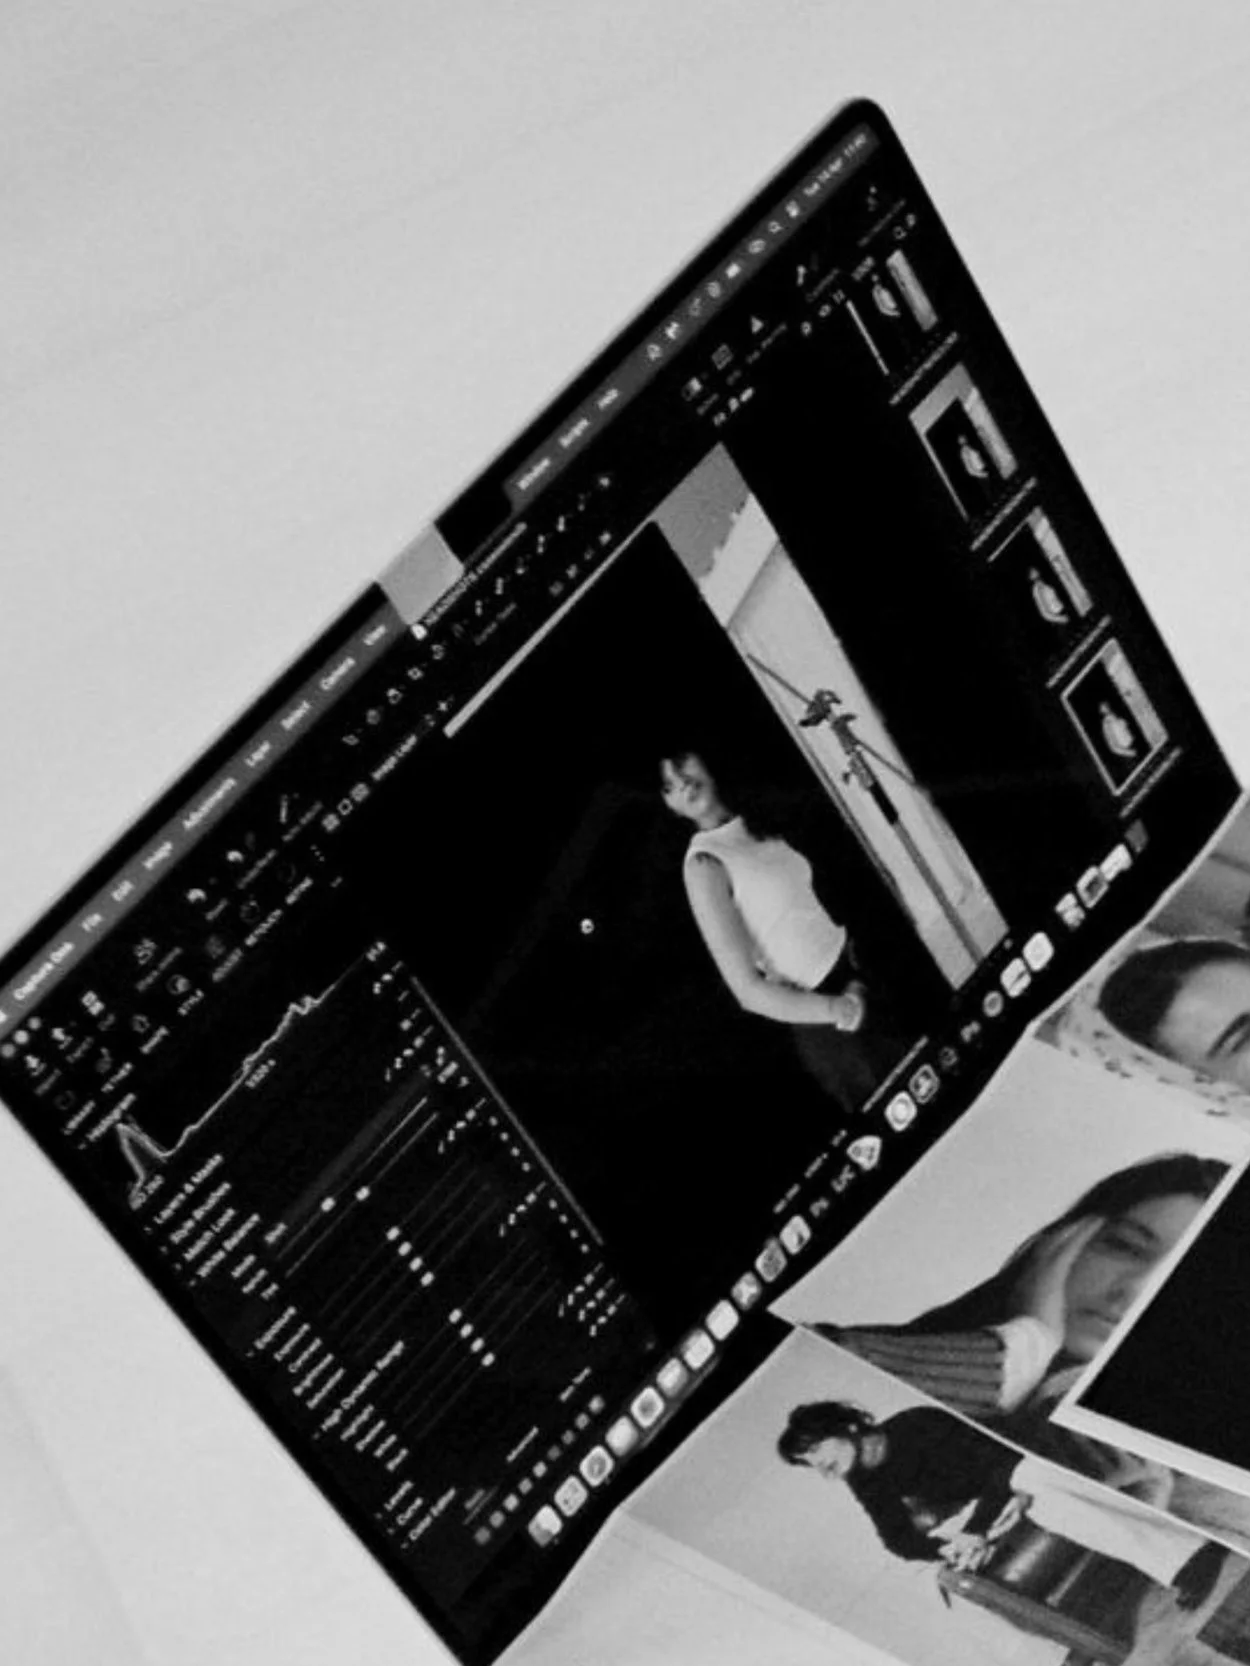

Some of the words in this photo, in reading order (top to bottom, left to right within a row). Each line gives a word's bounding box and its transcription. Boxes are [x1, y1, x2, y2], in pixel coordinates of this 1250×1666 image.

[517, 457, 551, 490] Window
[362, 624, 386, 646] View
[320, 656, 355, 690] Camera
[280, 700, 310, 730] Select
[142, 840, 173, 870] Image
[110, 879, 134, 902] Edit
[81, 912, 102, 932] File
